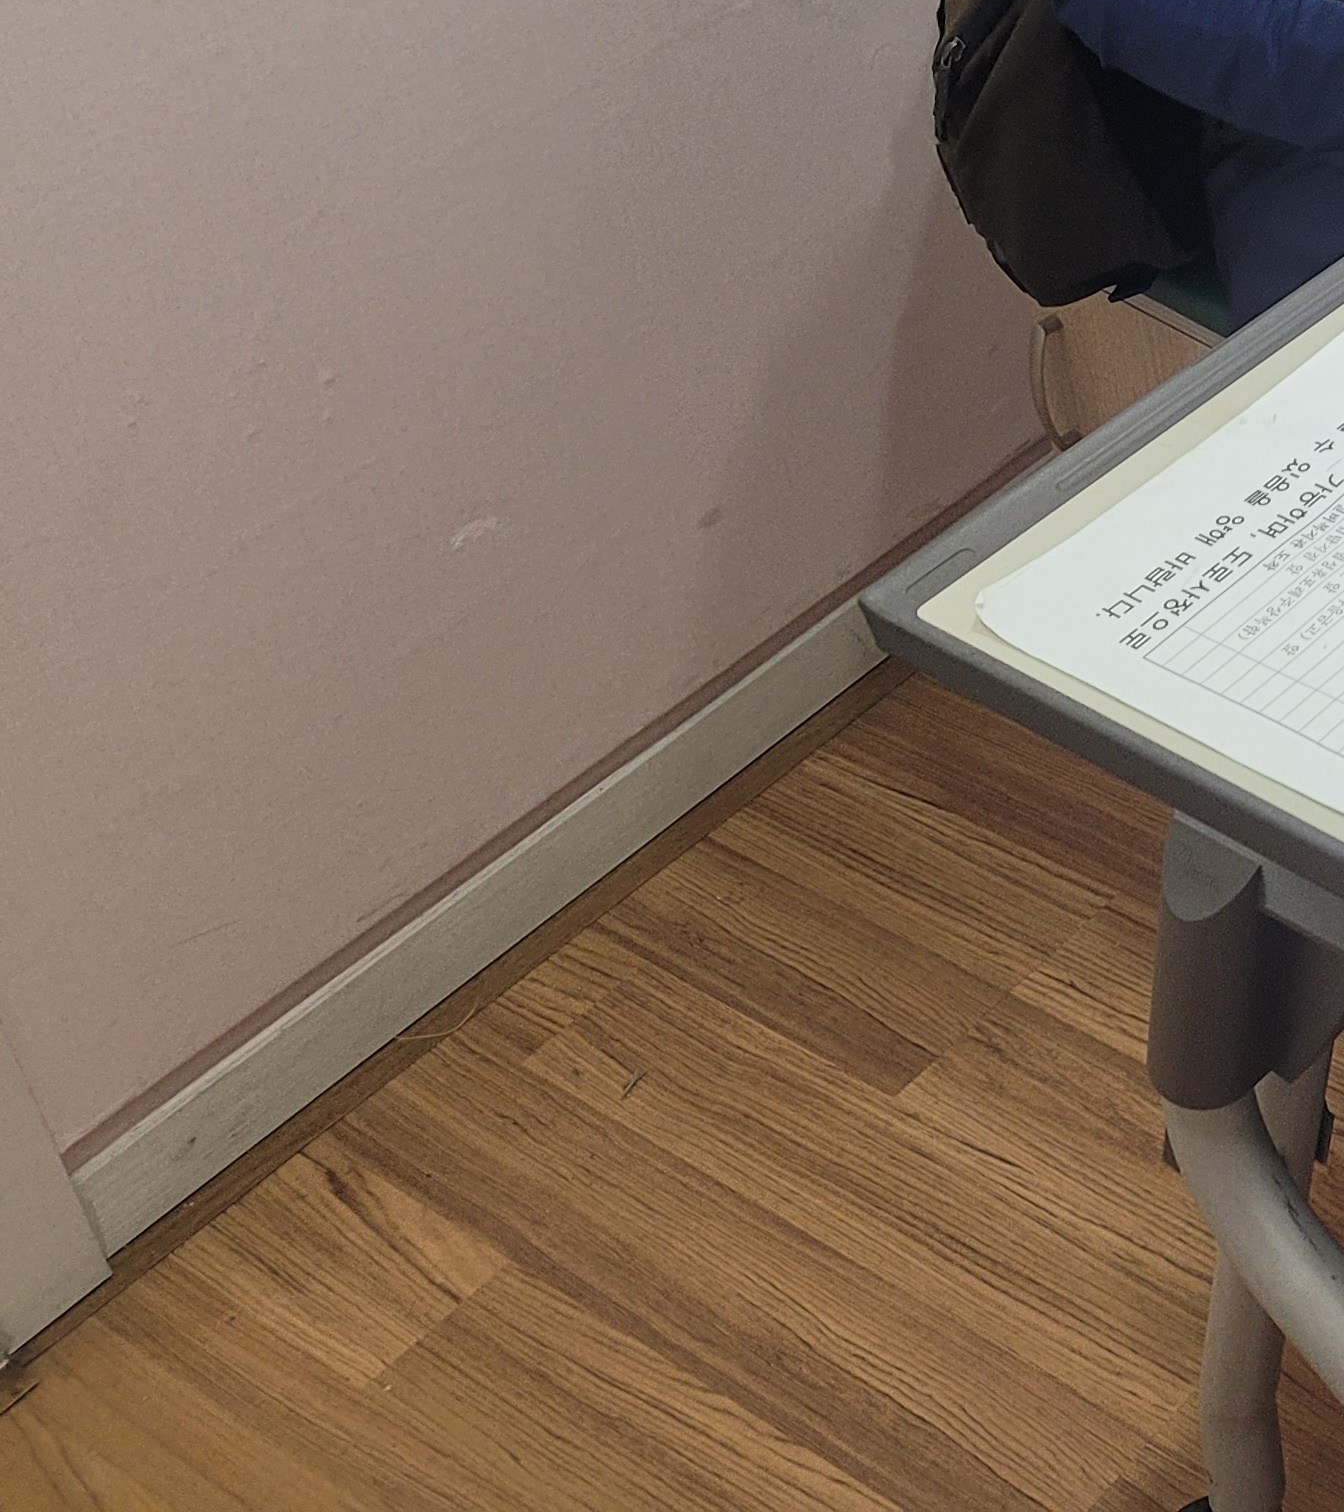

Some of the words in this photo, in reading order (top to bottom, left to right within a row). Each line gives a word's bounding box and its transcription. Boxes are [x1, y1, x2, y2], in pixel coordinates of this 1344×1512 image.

[1307, 435, 1341, 456] 수
[1240, 457, 1316, 510] 있음을
[1190, 509, 1248, 548] 양해
[1092, 548, 1198, 625] 바랍니다.
[1114, 544, 1256, 652] 도로사정으로
